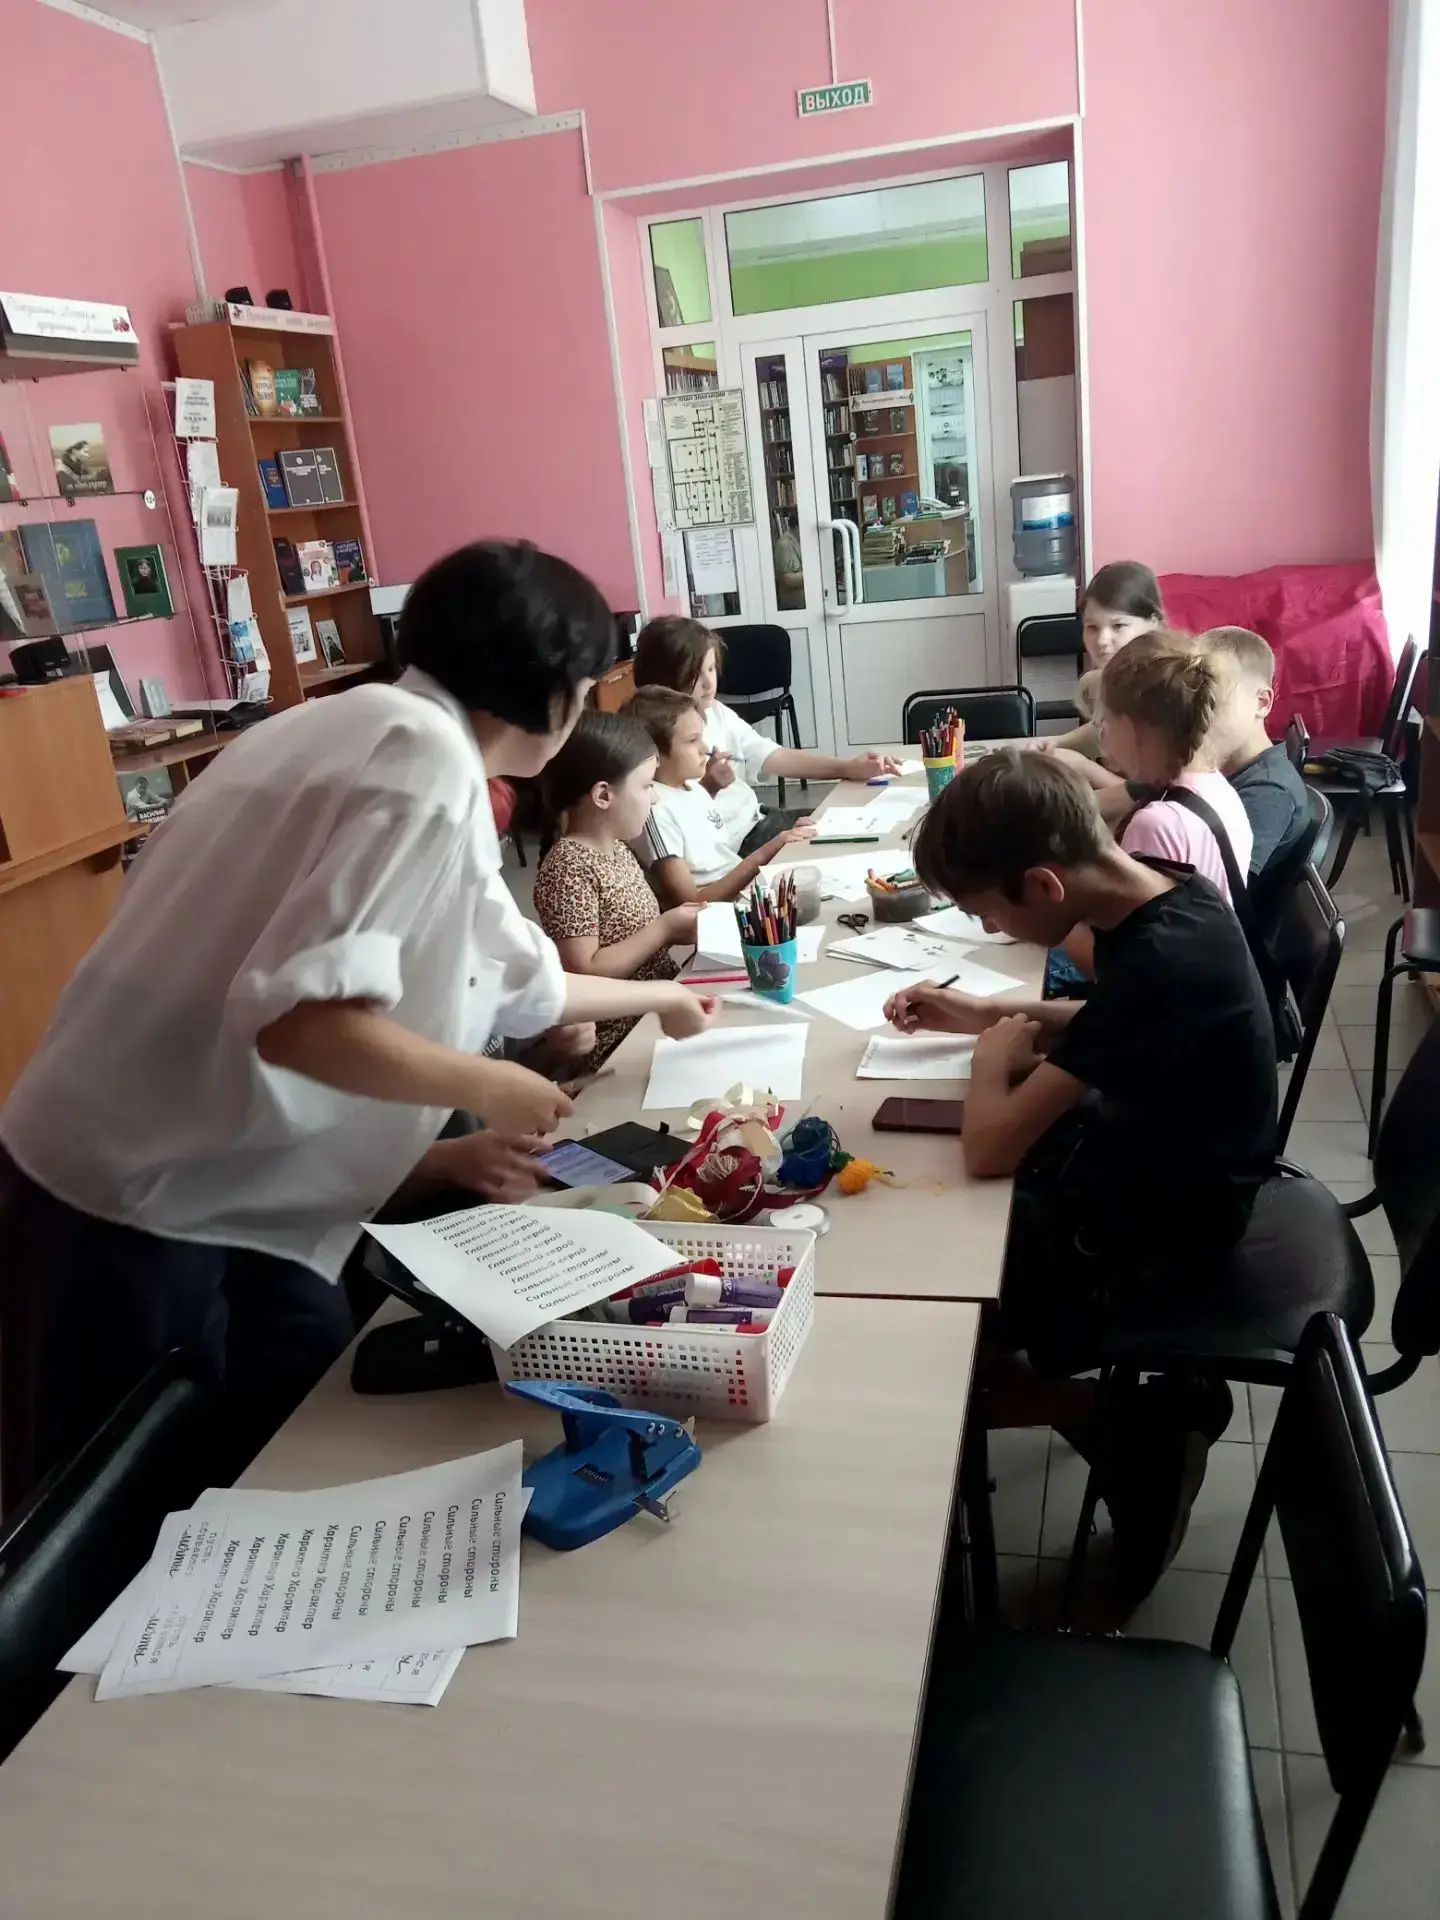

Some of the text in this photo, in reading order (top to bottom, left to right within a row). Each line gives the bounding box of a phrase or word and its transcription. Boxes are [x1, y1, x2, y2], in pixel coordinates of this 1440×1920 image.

[805, 86, 865, 111] ВЫХОД
[465, 1232, 508, 1255] Главный
[476, 1224, 551, 1262] Главный герой
[500, 1239, 574, 1277] Главный герой
[511, 1247, 586, 1284] Главный герой
[514, 1249, 608, 1295] Сильные стороны
[526, 1280, 573, 1302] Сильные
[575, 1256, 621, 1282] стороны
[534, 1232, 562, 1249] герой
[539, 1288, 586, 1310] Сильные
[587, 1265, 635, 1289] стороны
[220, 1536, 266, 1640] Характер Характер
[247, 1532, 290, 1637] Характер Характер
[275, 1528, 315, 1633] Характер Характер
[301, 1523, 339, 1630] Характер Характер
[332, 1525, 362, 1620] Сильные стороны
[358, 1520, 386, 1616] Сильные стороны
[385, 1515, 411, 1612] Сильные стороны
[412, 1511, 435, 1608] Сильные стороны
[438, 1505, 458, 1603] Сильные стороны
[464, 1498, 482, 1598] Сильные стороны
[490, 1491, 506, 1592] Сильные стороны
[193, 1539, 240, 1643] Характер Характер
